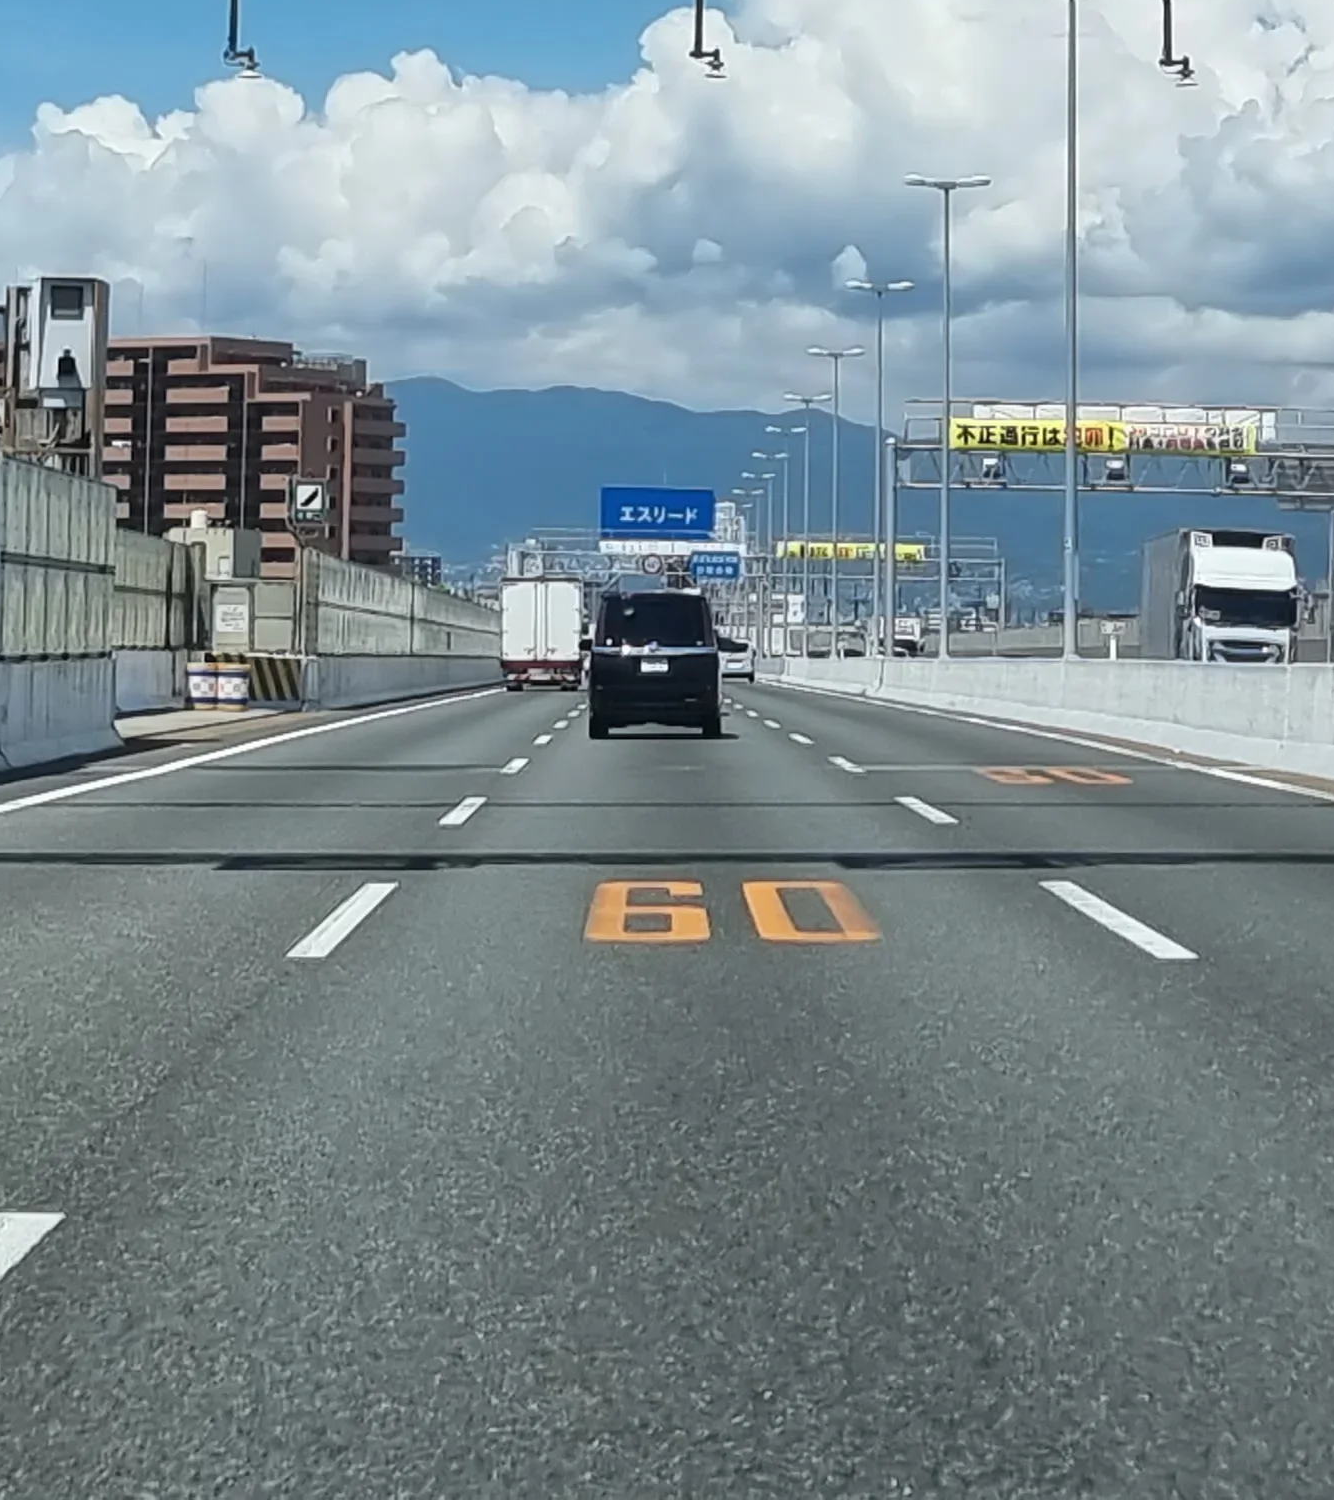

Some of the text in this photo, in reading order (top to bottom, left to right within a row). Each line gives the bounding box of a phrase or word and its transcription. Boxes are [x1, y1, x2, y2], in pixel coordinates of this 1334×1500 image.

[618, 504, 700, 526] エスリード
[583, 879, 881, 943] 60
